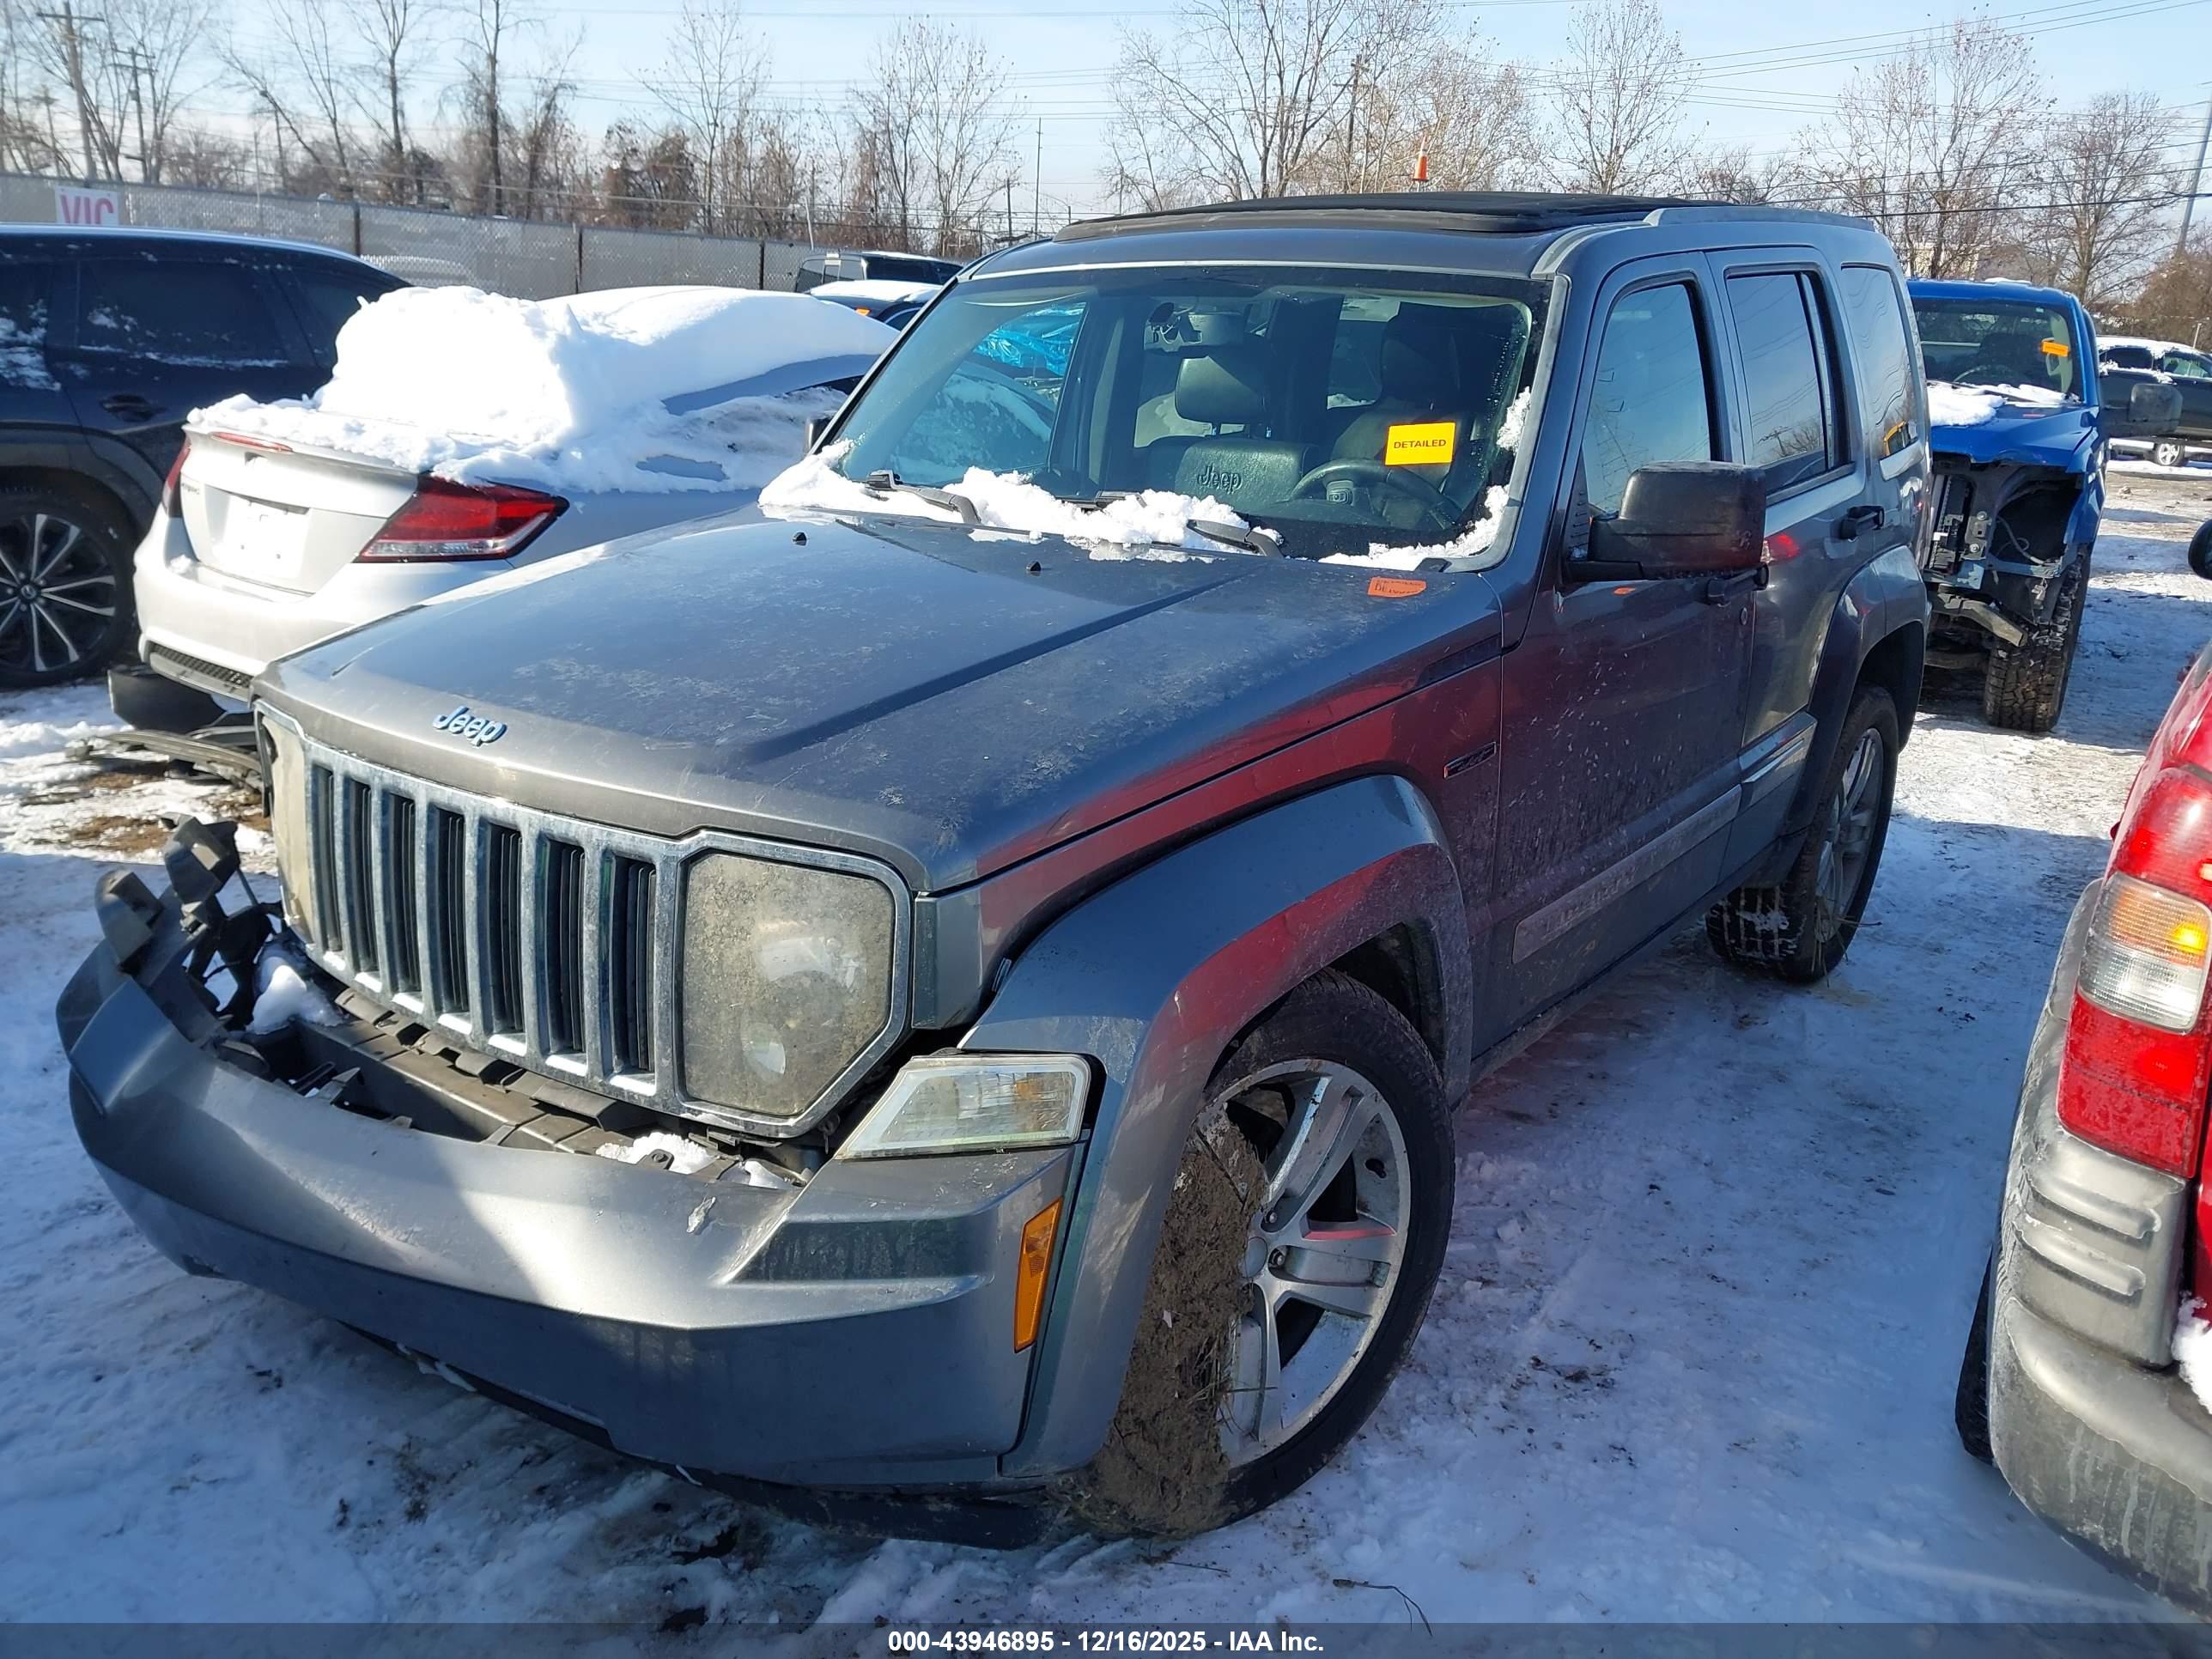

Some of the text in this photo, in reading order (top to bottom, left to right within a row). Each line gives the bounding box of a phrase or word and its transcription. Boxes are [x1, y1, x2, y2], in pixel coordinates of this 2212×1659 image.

[1394, 439, 1447, 449] DETAILED
[1197, 464, 1243, 495] Jeep
[432, 704, 508, 748] Jeep
